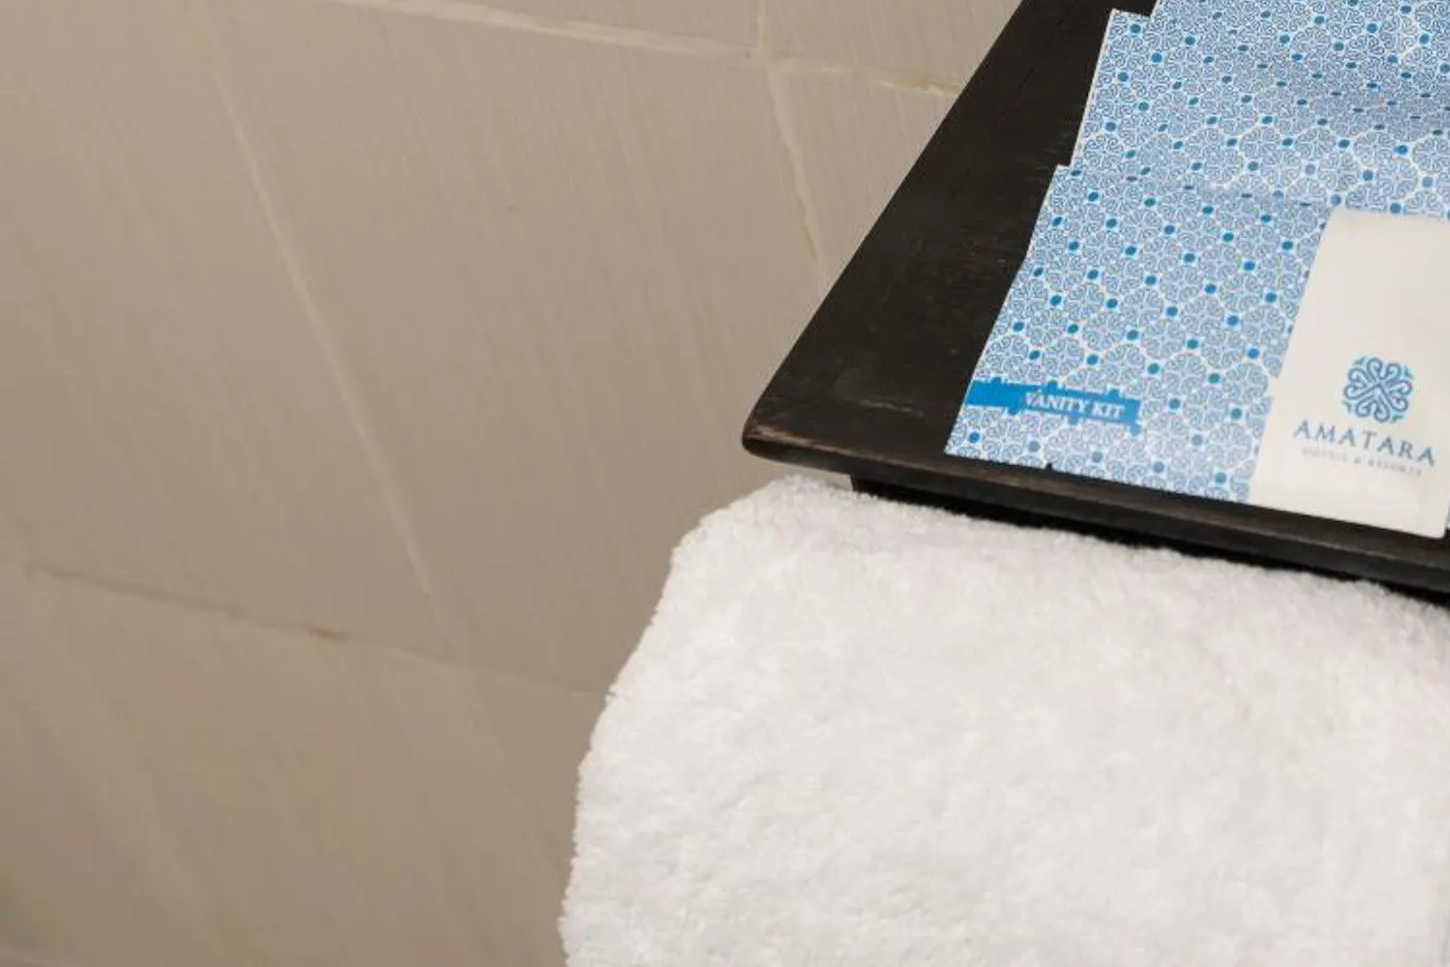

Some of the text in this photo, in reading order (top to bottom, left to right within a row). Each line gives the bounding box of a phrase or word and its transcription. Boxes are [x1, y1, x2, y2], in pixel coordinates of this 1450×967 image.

[1025, 391, 1124, 419] VANITY KIT
[1293, 419, 1435, 467] AMATARA
